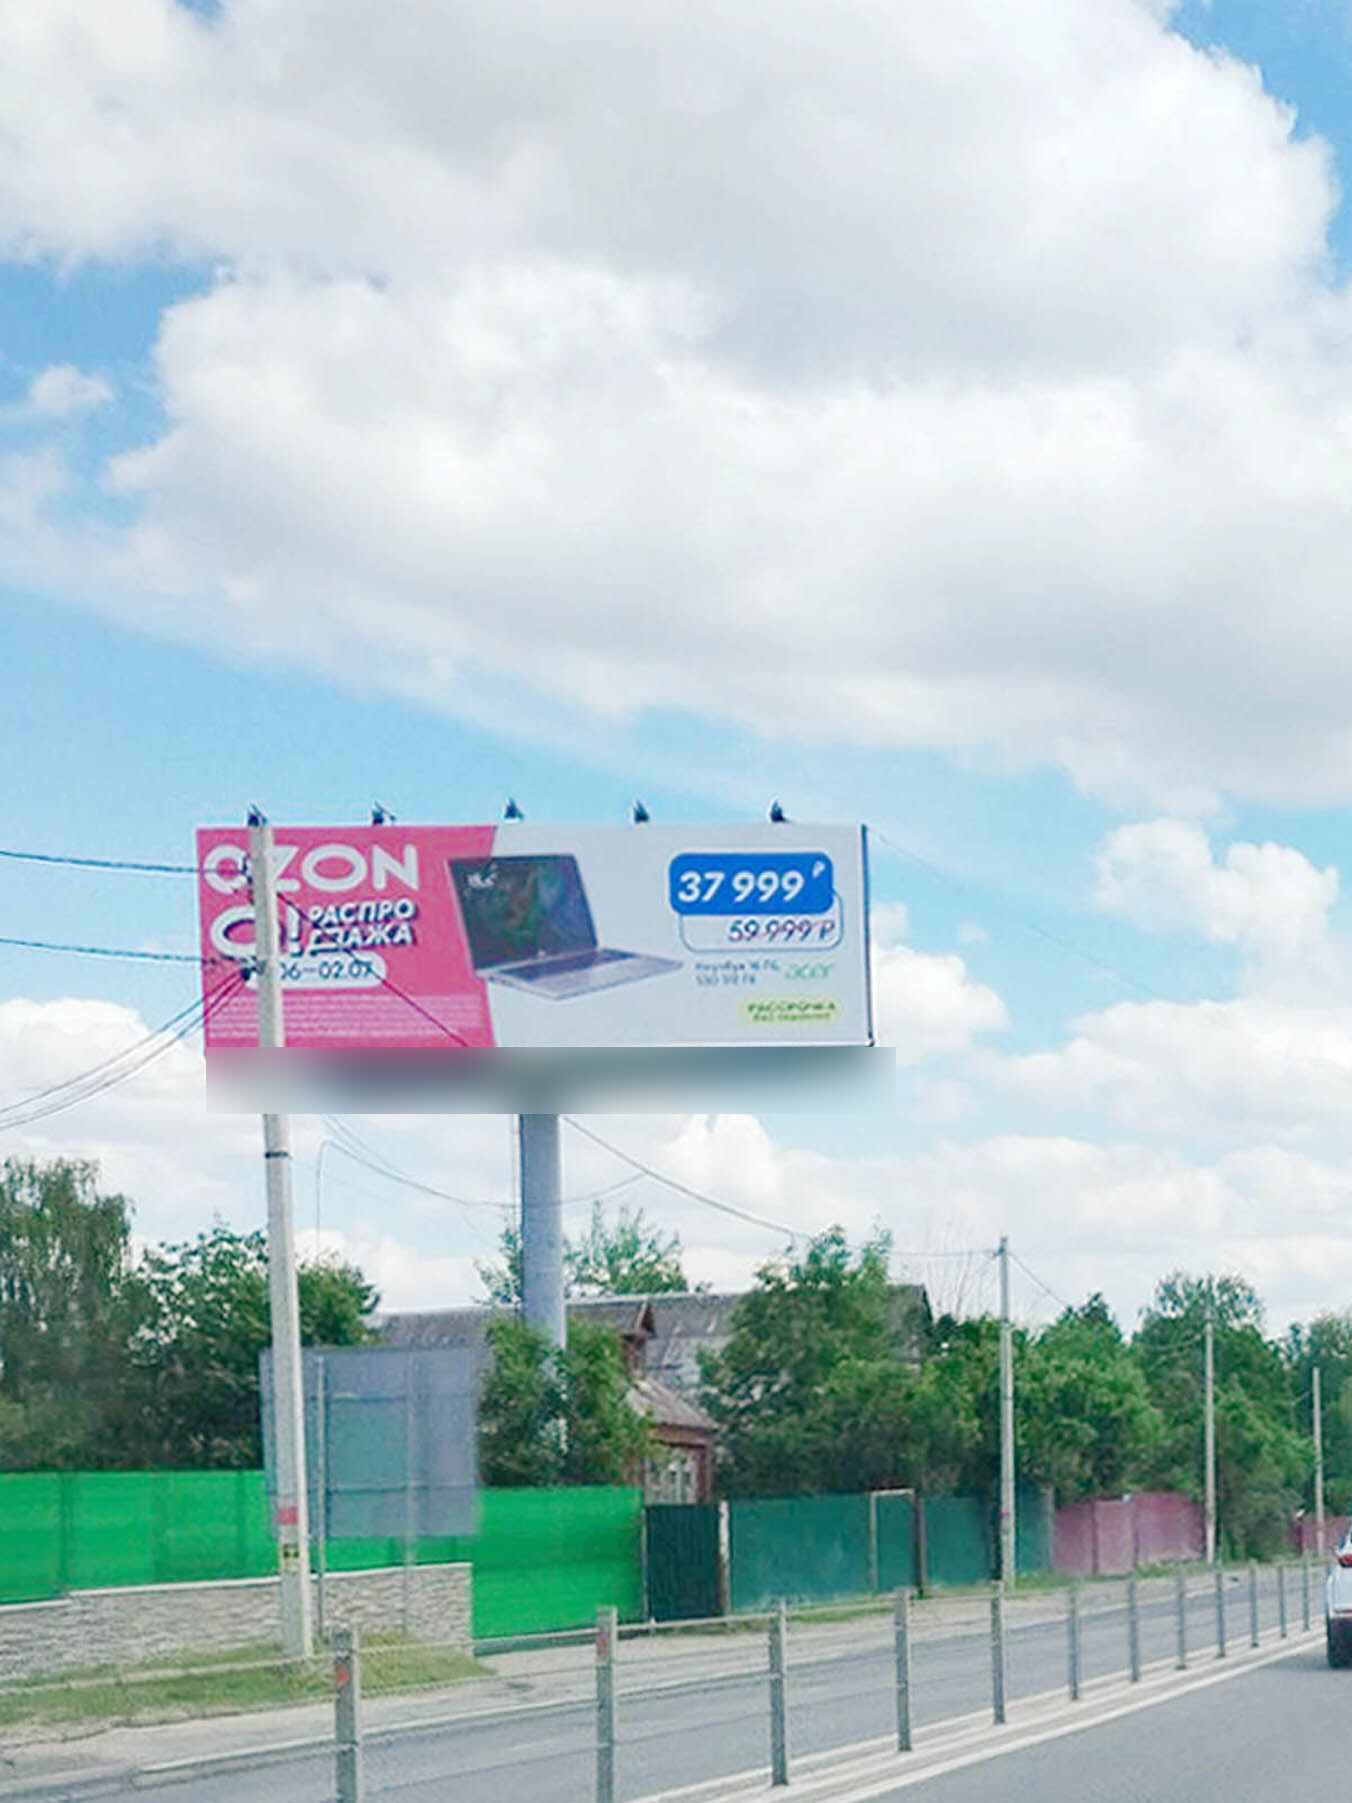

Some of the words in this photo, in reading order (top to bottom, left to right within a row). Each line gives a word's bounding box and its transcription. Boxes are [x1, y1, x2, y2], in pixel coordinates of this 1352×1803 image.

[203, 843, 419, 894] OZON
[678, 871, 725, 904] 37
[732, 870, 804, 904] 999
[308, 897, 416, 926] РАСПРО
[728, 920, 760, 942] 59
[765, 919, 813, 942] 999
